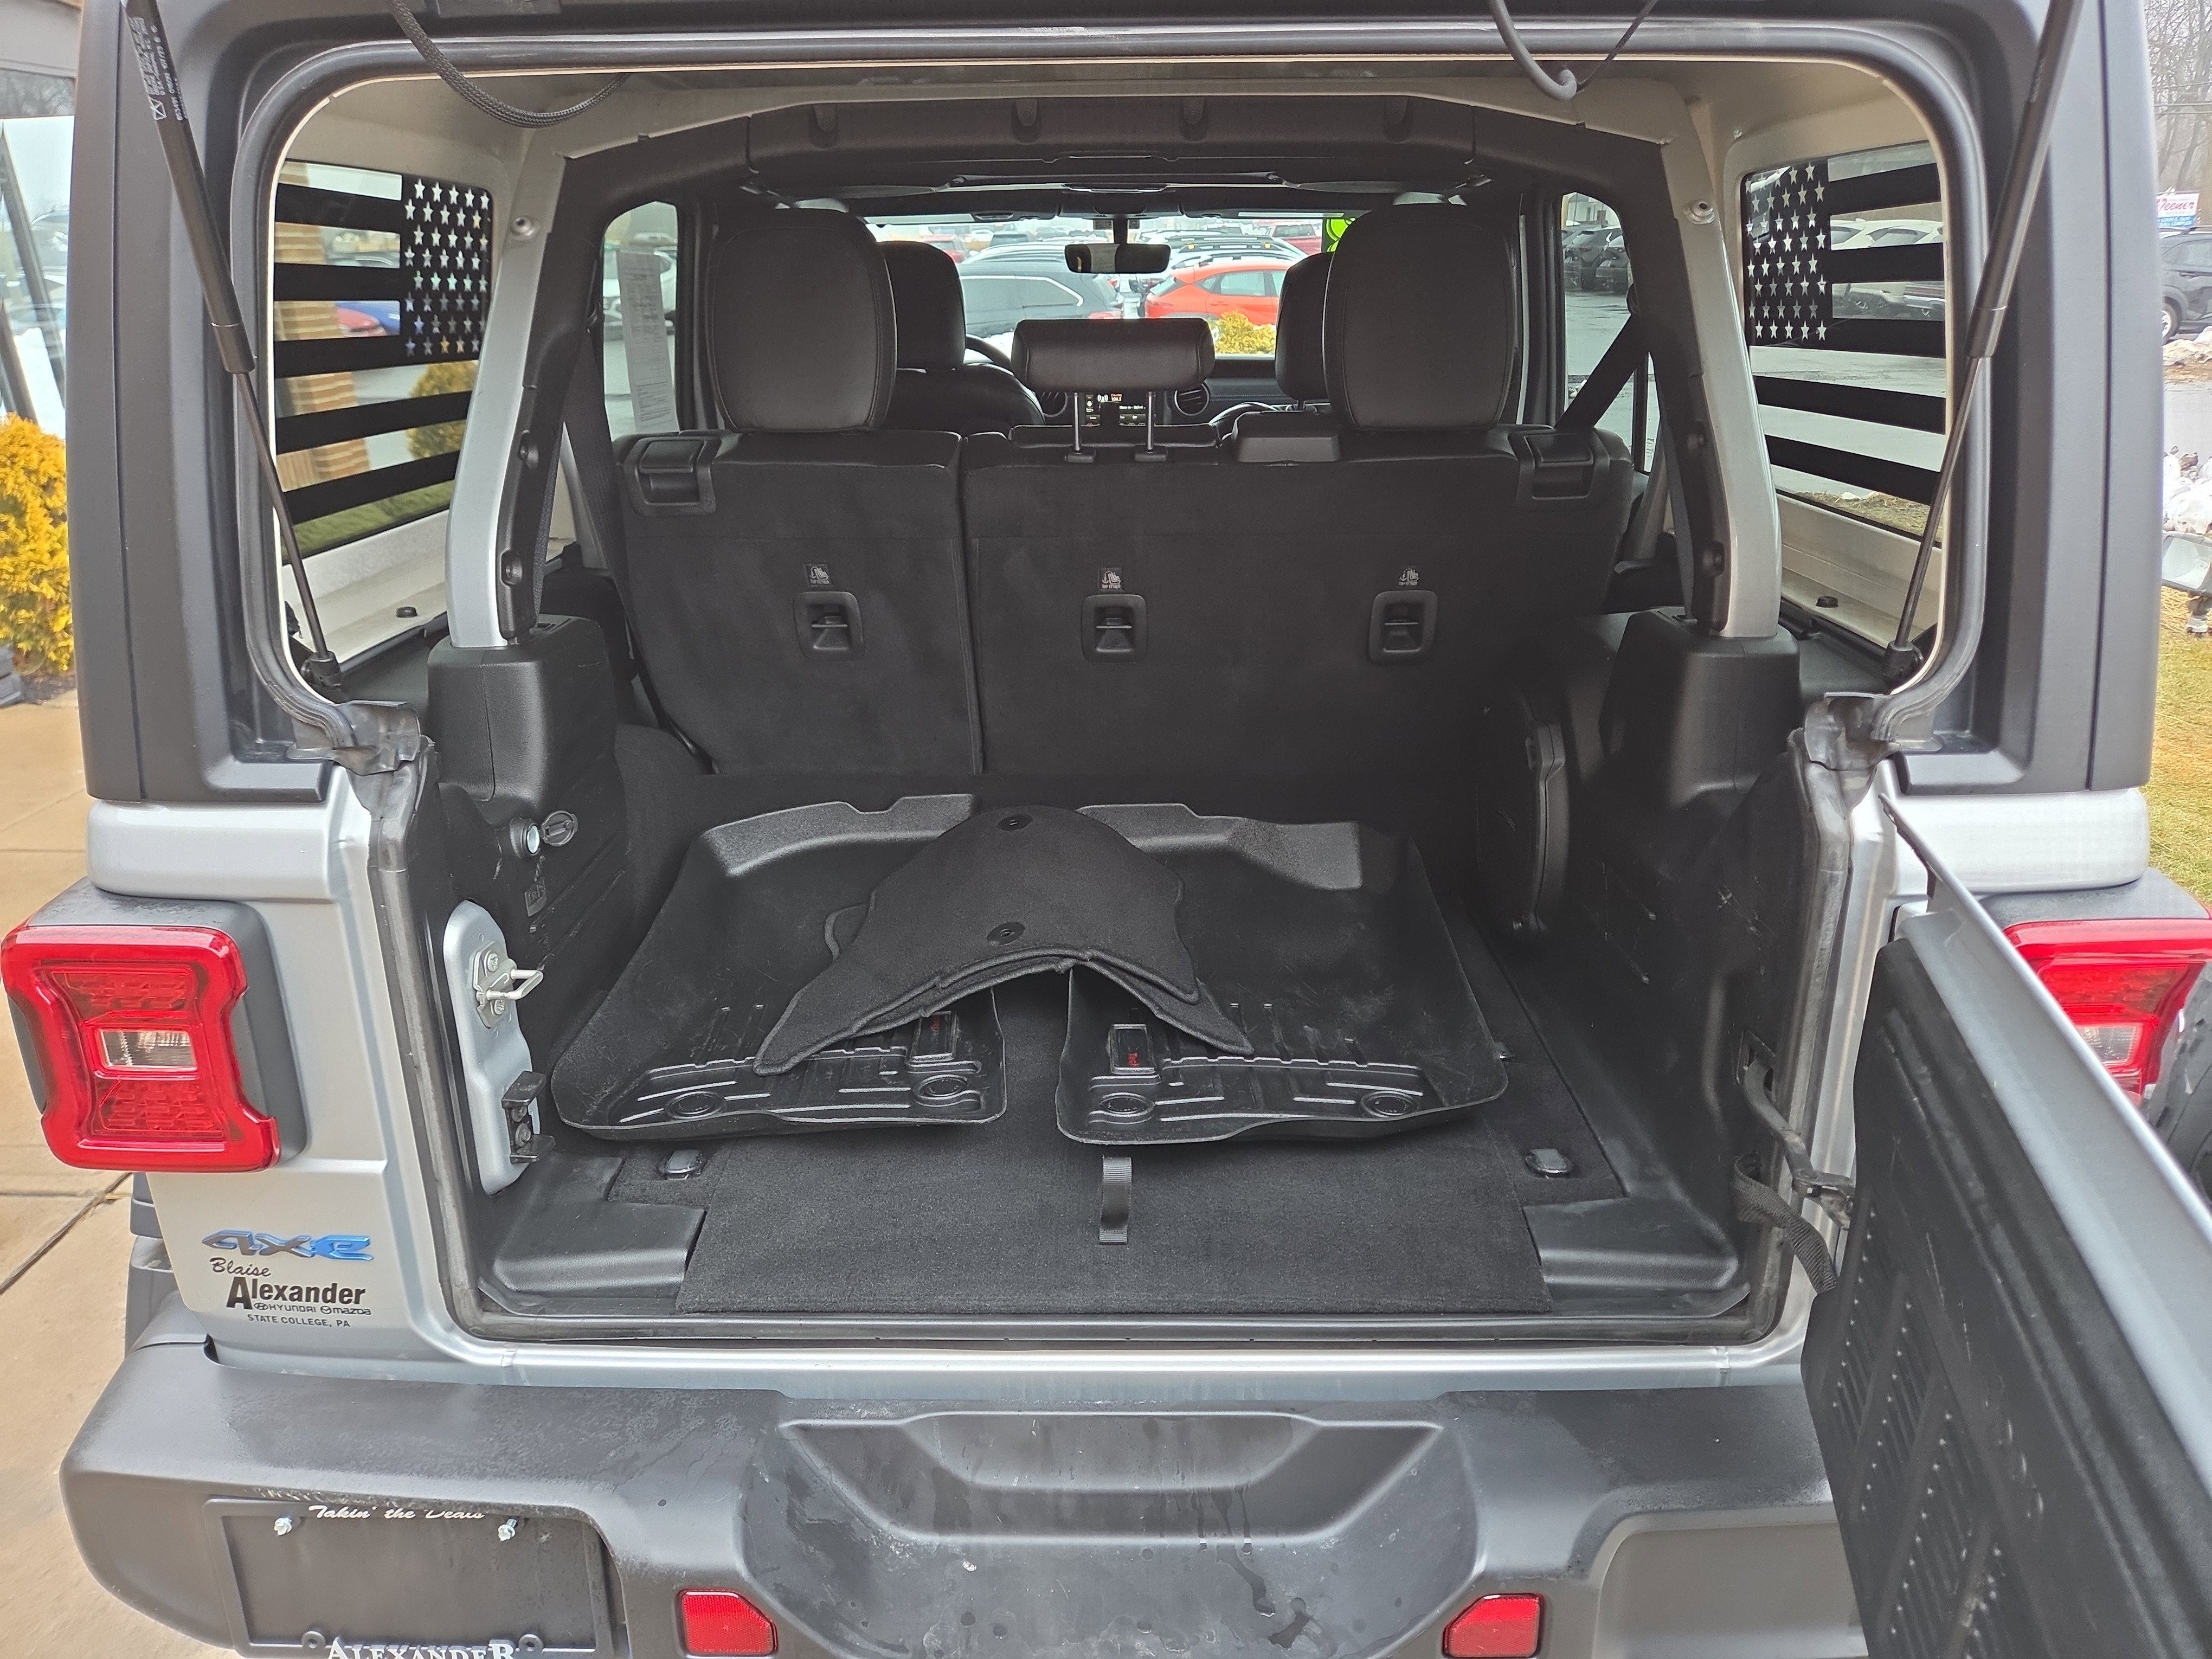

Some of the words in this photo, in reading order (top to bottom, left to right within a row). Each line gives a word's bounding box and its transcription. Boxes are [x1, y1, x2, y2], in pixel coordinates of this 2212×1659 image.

[210, 1257, 271, 1277] Blaise
[226, 1276, 366, 1310] Alexander
[269, 1303, 317, 1313] HYUNDAI
[247, 1314, 278, 1323] STATE
[280, 1316, 332, 1327] COLLEGE,
[384, 1508, 416, 1519] the
